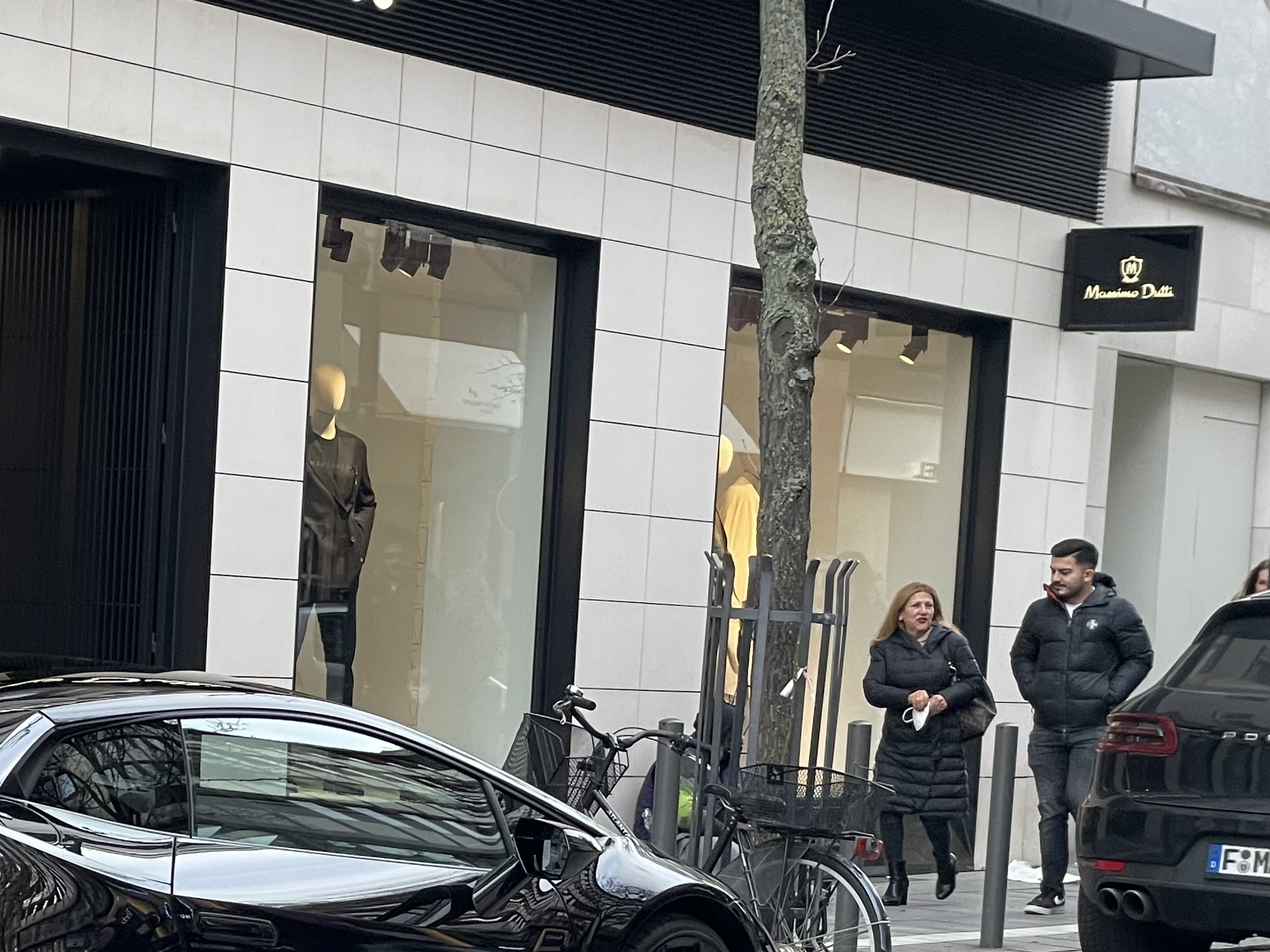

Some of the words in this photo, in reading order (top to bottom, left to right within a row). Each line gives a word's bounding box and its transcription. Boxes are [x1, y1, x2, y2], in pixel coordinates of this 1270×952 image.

[1083, 284, 1139, 300] Massimo
[1141, 283, 1174, 299] Dutti
[1222, 848, 1239, 871] F
